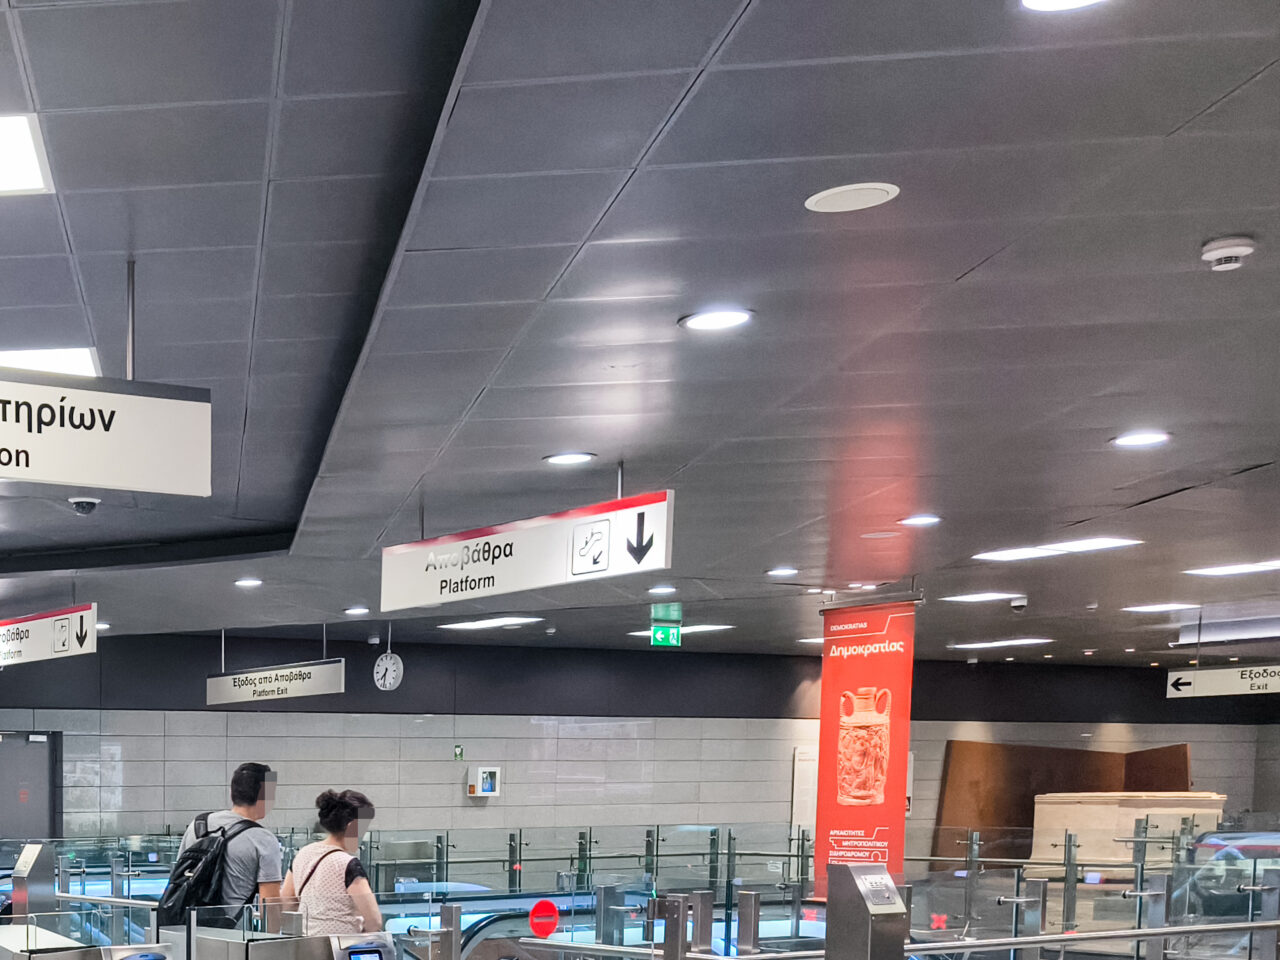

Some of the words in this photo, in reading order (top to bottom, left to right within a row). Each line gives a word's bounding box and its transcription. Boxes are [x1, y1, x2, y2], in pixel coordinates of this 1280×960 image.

[425, 542, 514, 572] Αποβάθρα
[440, 575, 495, 595] Platform
[829, 640, 904, 660] Δημοκρατίας
[274, 670, 312, 682] Αποβάθρα
[252, 688, 276, 698] Platform
[277, 687, 288, 695] Exit
